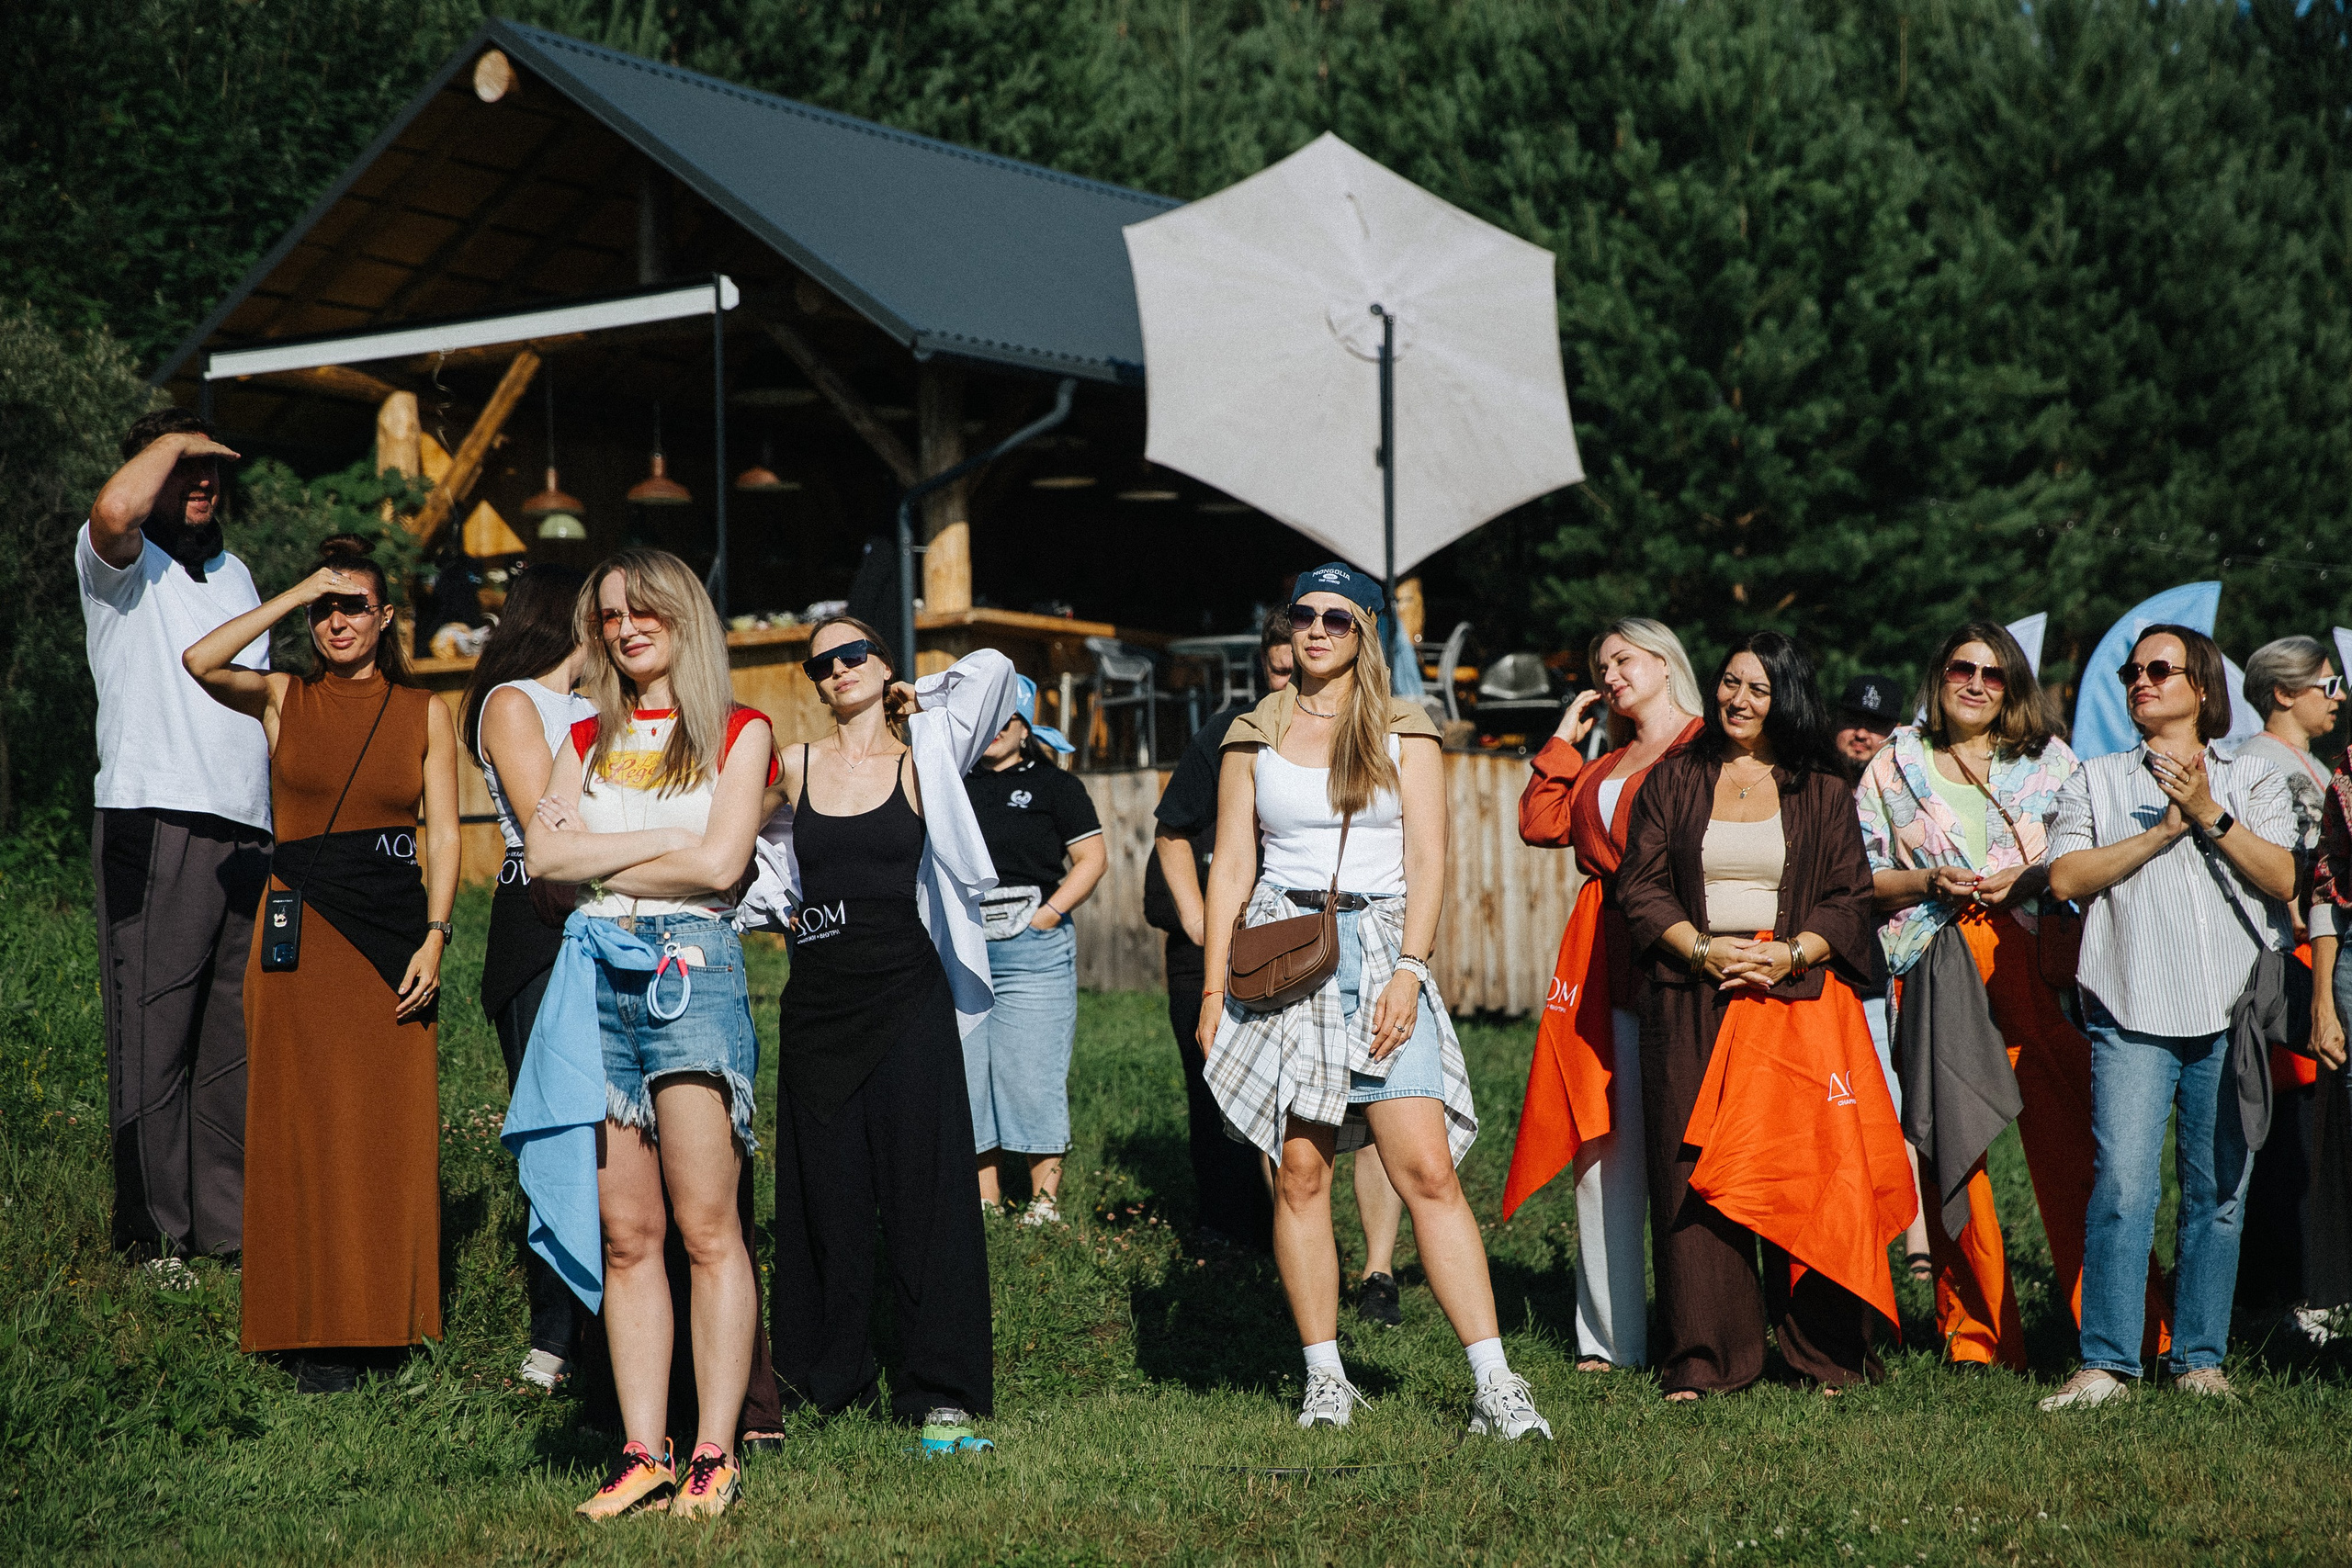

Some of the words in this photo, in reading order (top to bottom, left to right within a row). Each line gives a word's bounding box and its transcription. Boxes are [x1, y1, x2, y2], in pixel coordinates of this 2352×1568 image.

[1312, 569, 1351, 581] MONGOLIA
[375, 833, 417, 858] ДО
[1547, 976, 1578, 1007] ОМ
